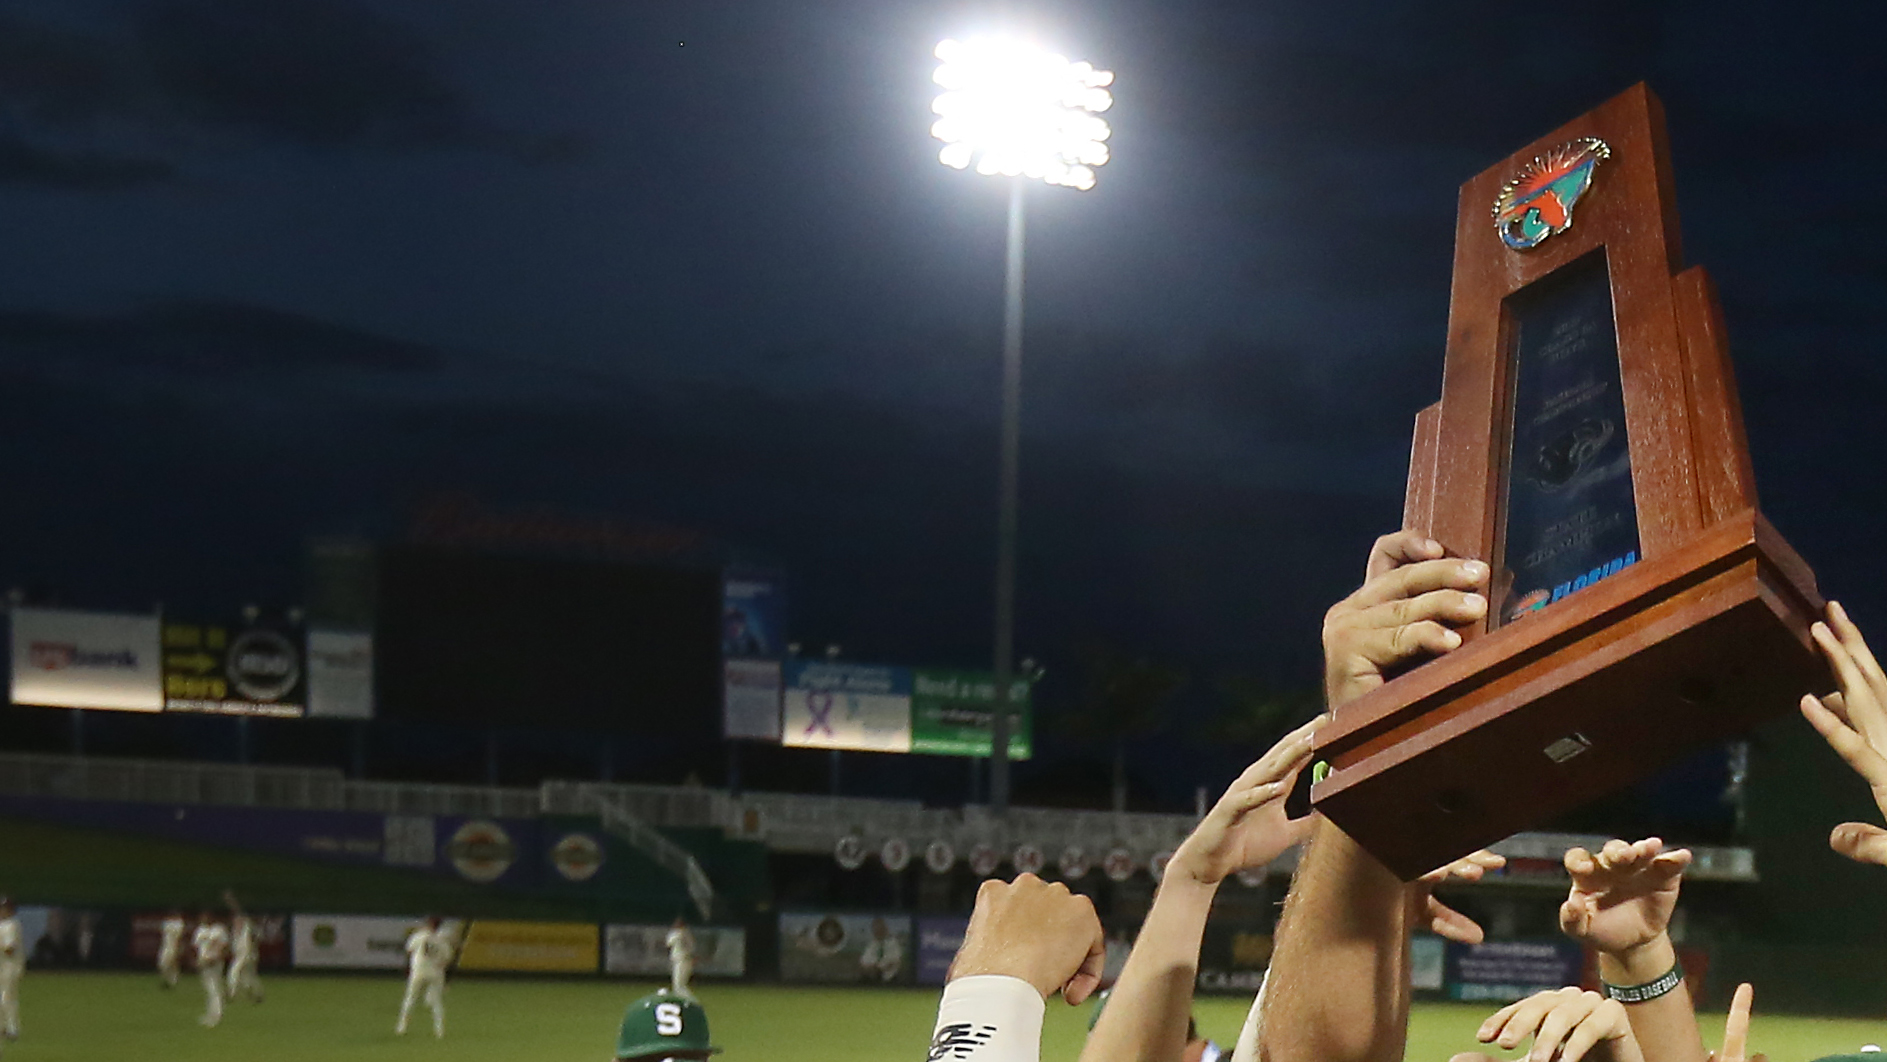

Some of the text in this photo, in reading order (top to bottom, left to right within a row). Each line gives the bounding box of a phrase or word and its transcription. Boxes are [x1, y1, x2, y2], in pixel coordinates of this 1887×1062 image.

[1551, 551, 1635, 603] FLORIDA
[1641, 971, 1679, 999] BASEBALL
[655, 1004, 682, 1036] S
